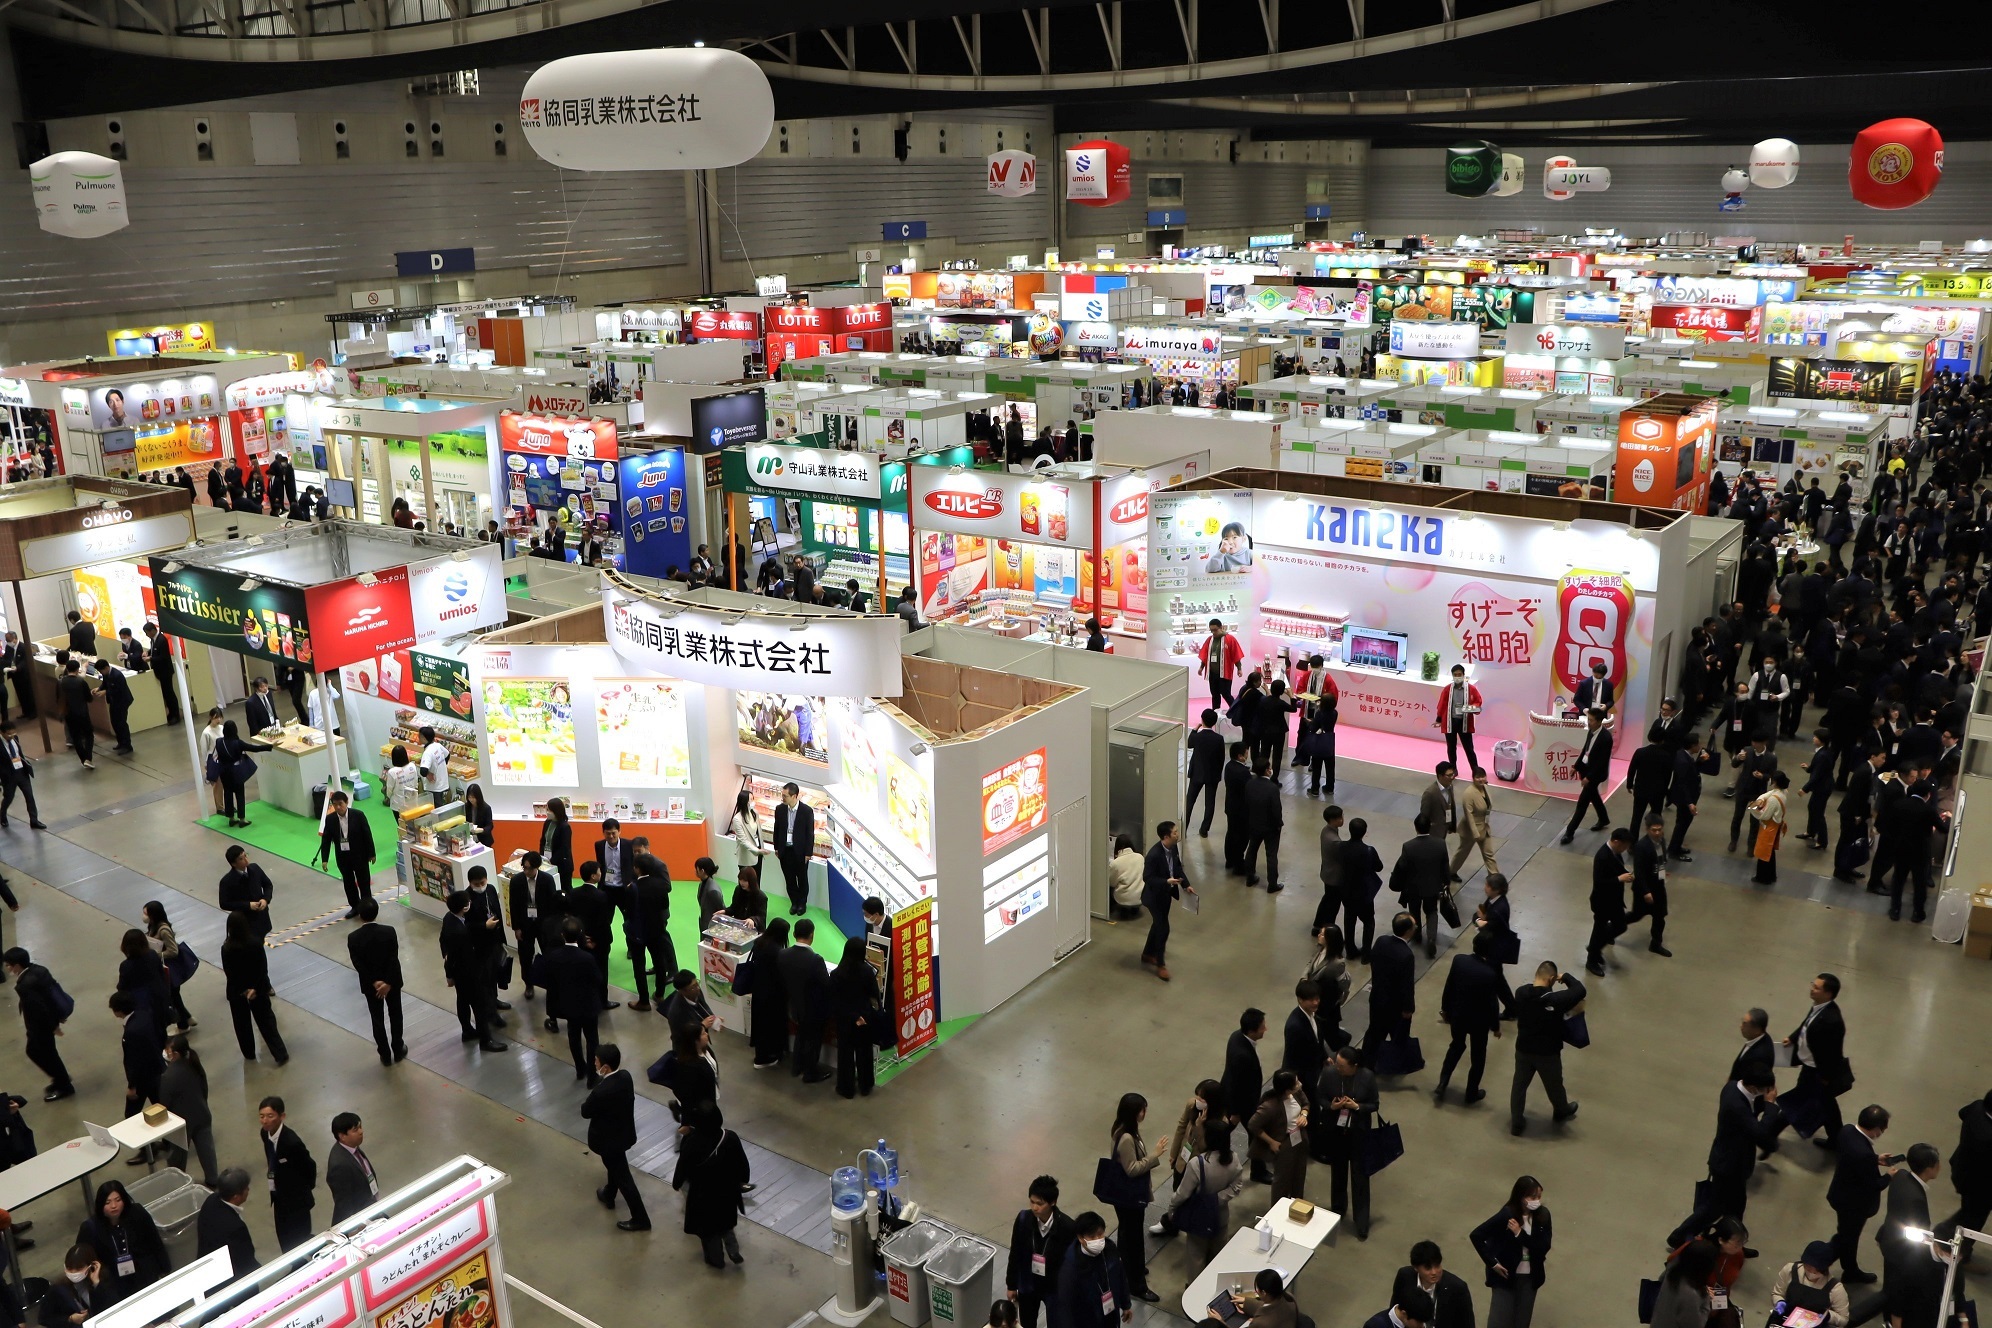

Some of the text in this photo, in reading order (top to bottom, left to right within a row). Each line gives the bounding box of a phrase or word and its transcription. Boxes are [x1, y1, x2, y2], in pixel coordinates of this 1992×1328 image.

[544, 93, 702, 127] 協同乳業株式会社
[1451, 162, 1480, 174] bibigo
[75, 180, 116, 191] Pulmuone
[1072, 174, 1095, 182] umios
[1561, 173, 1591, 185] JOYL
[1164, 212, 1170, 223] B
[902, 224, 910, 237] C
[430, 253, 444, 271] D
[634, 316, 680, 327] MORINAGA
[778, 314, 820, 327] LOTTE
[846, 310, 881, 326] LOTTE
[1145, 337, 1197, 352] imuraya
[1557, 341, 1592, 352] ヤマザキ
[1817, 380, 1862, 392] イチビキ
[543, 398, 585, 412] メロディアン
[332, 413, 362, 428] よつ葉
[517, 429, 551, 451] Luna
[1648, 443, 1672, 453] グループ
[636, 470, 668, 489] Luna
[788, 461, 869, 483] 守山乳業株式会社
[110, 486, 129, 496] OHAYO
[936, 492, 995, 514] エルビー
[82, 509, 133, 528] OHAYO
[1306, 503, 1444, 556] kaneka
[1563, 575, 1623, 587] すげーぞ細胞
[157, 584, 241, 627] Frutissier
[439, 602, 478, 623] umios
[1447, 598, 1542, 629] すげーぞ
[344, 619, 389, 636] MARUHA NICHIRO
[1567, 595, 1619, 649] Q
[375, 643, 386, 652] For
[386, 641, 396, 649] the
[630, 614, 832, 676] 協同乳業株式会社
[1462, 630, 1531, 665] 細胞
[1339, 690, 1432, 712] げーぞ細胞プロジェクト、
[1359, 704, 1403, 719] 始まります。
[1544, 750, 1580, 765] すげー
[896, 901, 930, 922] お試しください
[901, 925, 914, 1001] 測定実施中
[915, 918, 930, 995] 血管年齢
[408, 1232, 443, 1258] イチオシ!
[381, 1227, 472, 1285] うどんたれ まんぞくカレー
